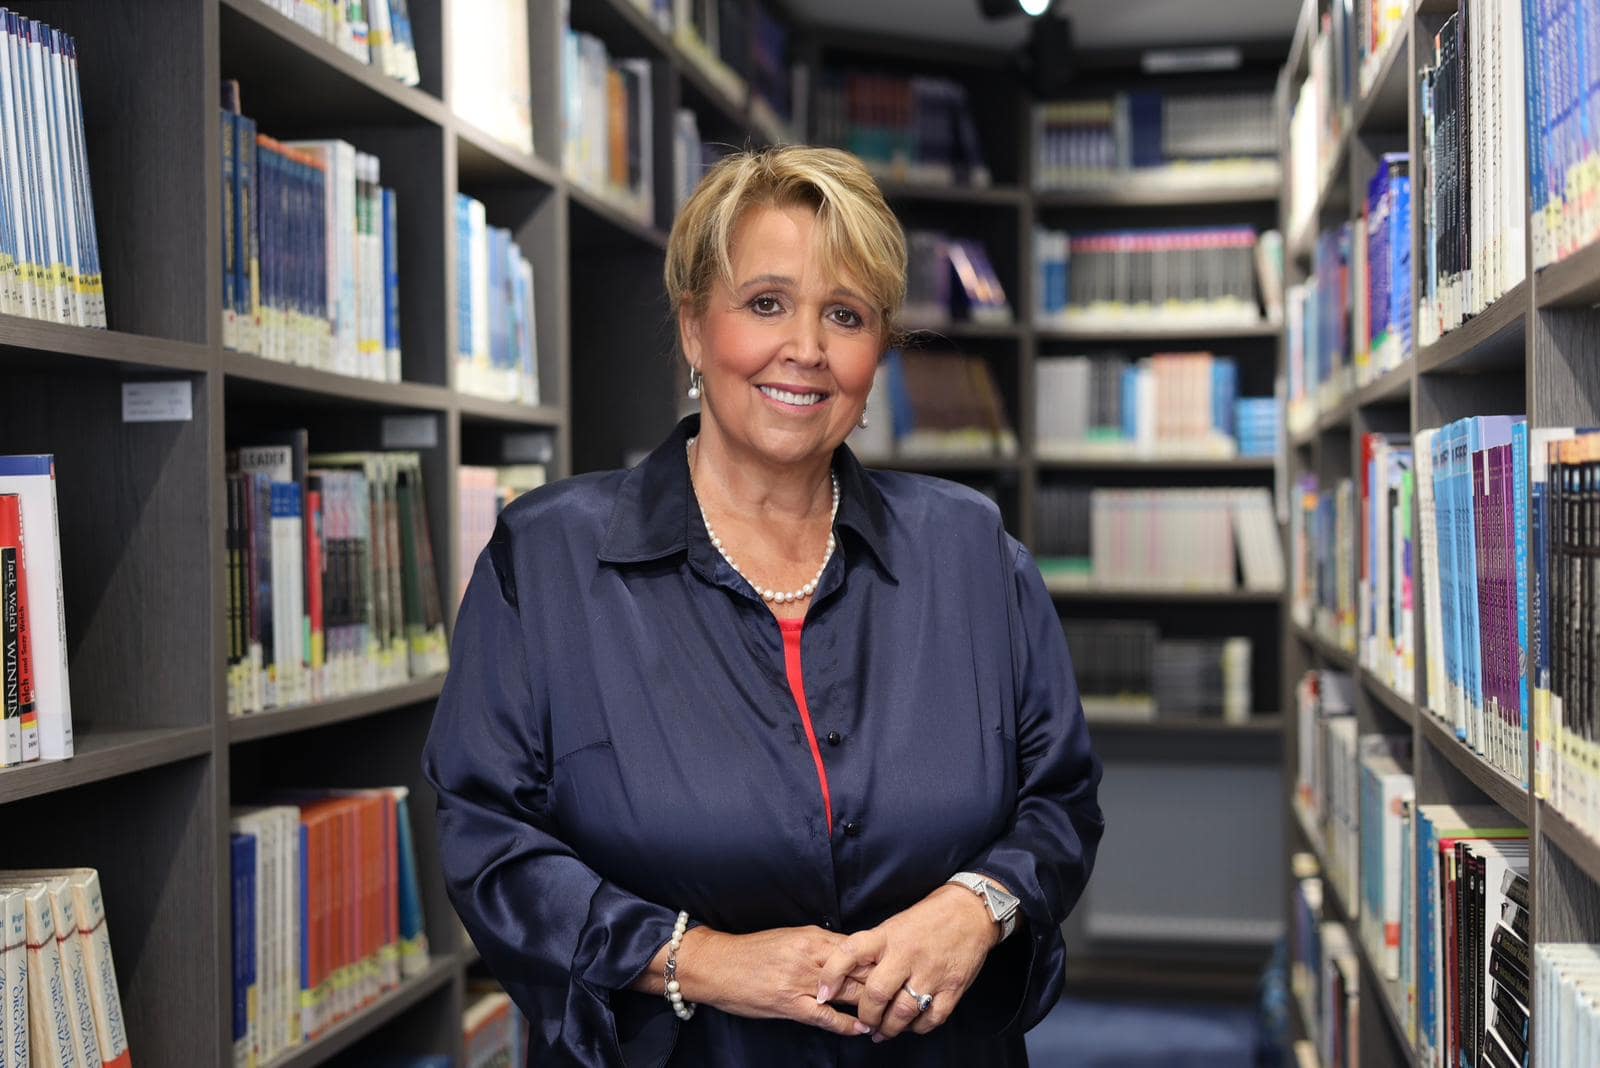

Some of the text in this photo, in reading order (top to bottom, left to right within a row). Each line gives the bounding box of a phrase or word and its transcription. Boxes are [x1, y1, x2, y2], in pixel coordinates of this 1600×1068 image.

[7, 559, 17, 718] Jack Welch WINNIN
[21, 679, 30, 702] elch
[13, 986, 21, 1068] ORGANIZA
[18, 959, 28, 1068] MANAGEME
[101, 961, 121, 1057] ORGANIZATIO
